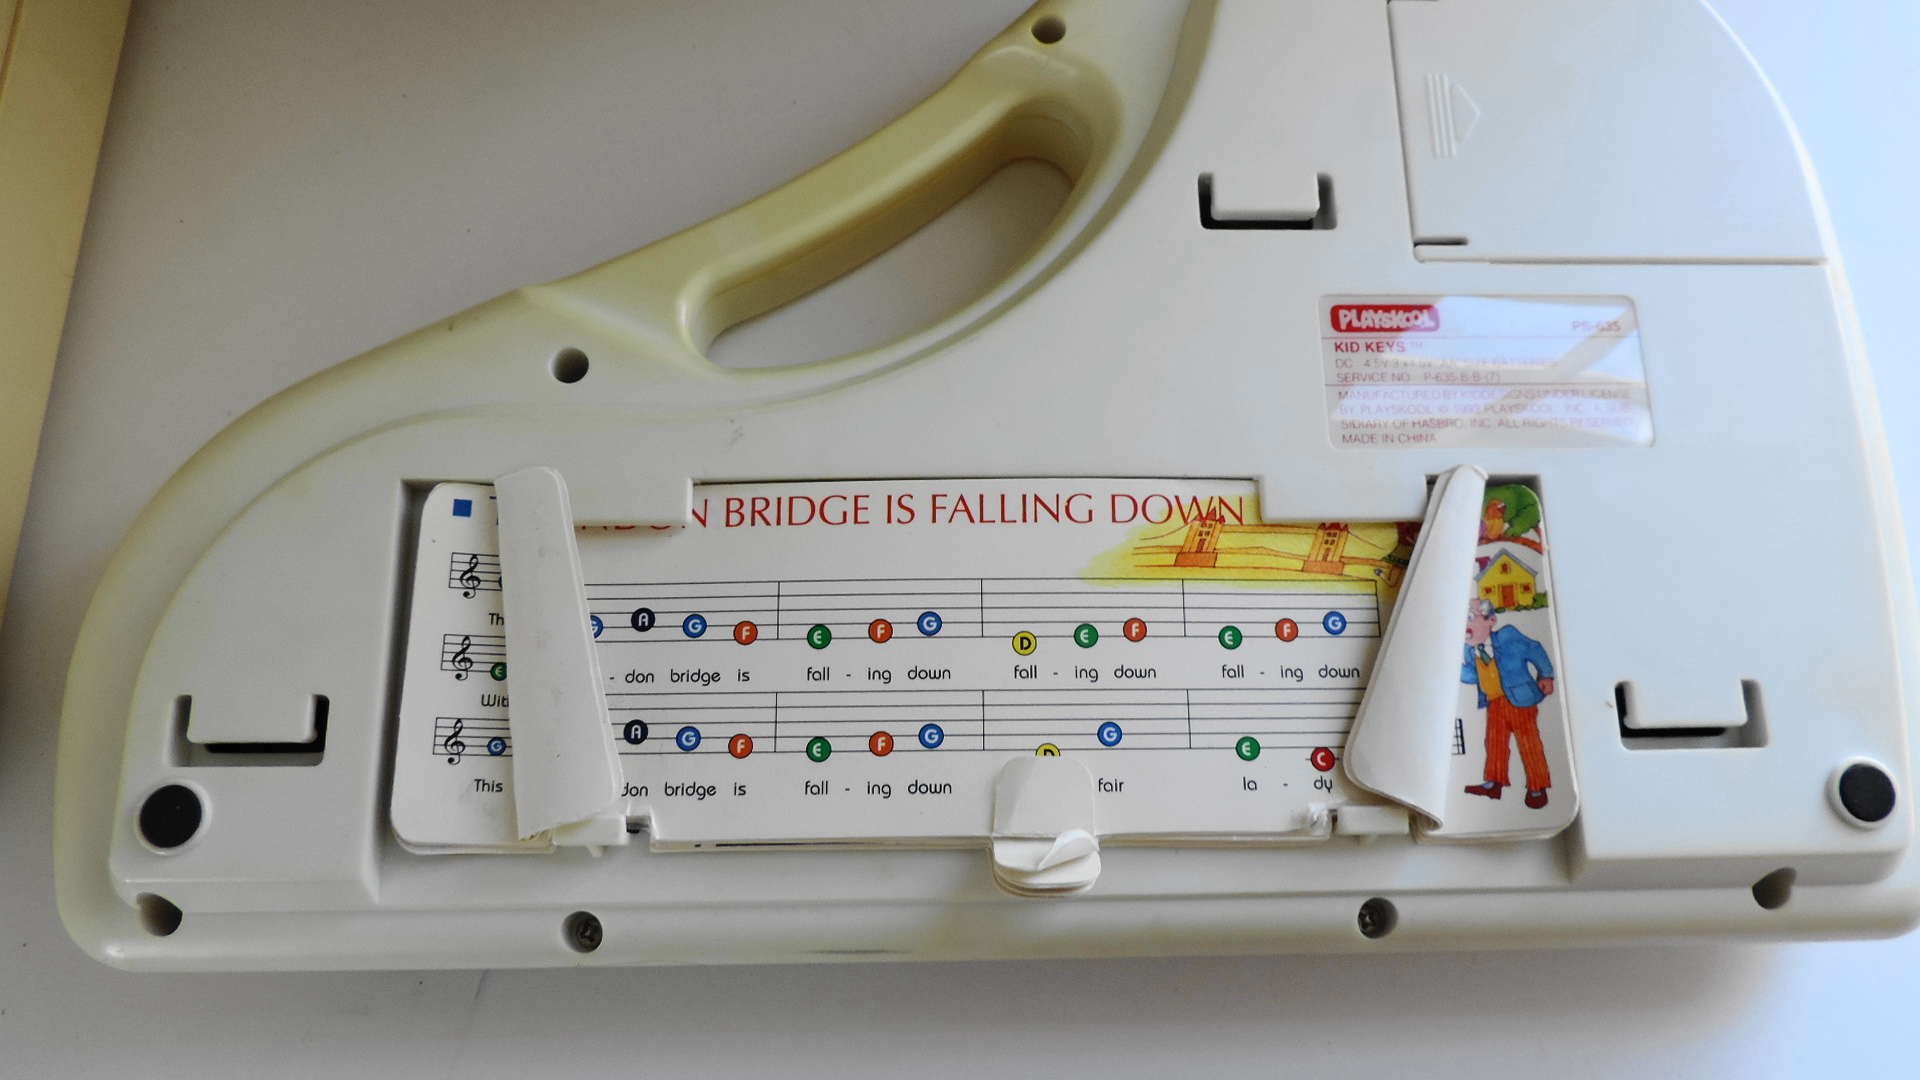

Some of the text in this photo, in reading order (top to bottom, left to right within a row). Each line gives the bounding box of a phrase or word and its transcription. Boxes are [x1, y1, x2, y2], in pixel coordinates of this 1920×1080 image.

[1338, 308, 1436, 330] PLAYSKOOL
[1334, 341, 1360, 353] KID
[1365, 341, 1406, 353] KEYS
[1335, 358, 1353, 369] DC
[1337, 372, 1388, 383] SERVICE
[1338, 390, 1440, 401] MANUFACTURED
[1443, 390, 1457, 401] BY
[1340, 405, 1355, 415] BY
[1360, 404, 1432, 415] PLAYSKOOL
[1341, 419, 1388, 430] SIDIARY
[1392, 419, 1408, 429] OF
[1497, 418, 1520, 429] ALL
[1342, 433, 1437, 444] MADE IN CHINA
[726, 495, 870, 528] BRIDGE
[887, 495, 916, 525] IS
[931, 494, 1093, 524] FALLING
[1111, 494, 1244, 526] DOWN
[624, 669, 655, 684] don
[670, 668, 721, 687] bridge
[737, 668, 750, 682] is
[807, 666, 830, 682] fall
[867, 666, 892, 685] ing
[907, 665, 951, 680] down
[1014, 664, 1038, 680] fall
[1075, 665, 1099, 682] ing
[1113, 664, 1157, 679] down
[1221, 664, 1245, 679] fall
[1280, 665, 1304, 683] ing
[1318, 663, 1361, 679] down
[474, 778, 504, 793] This
[664, 781, 717, 801] bridge
[733, 781, 747, 796] is
[804, 780, 829, 796] fall
[867, 780, 892, 799] ing
[907, 780, 952, 795] down
[1098, 777, 1125, 793] fair
[1242, 776, 1258, 791] la
[1313, 776, 1334, 794] dy
